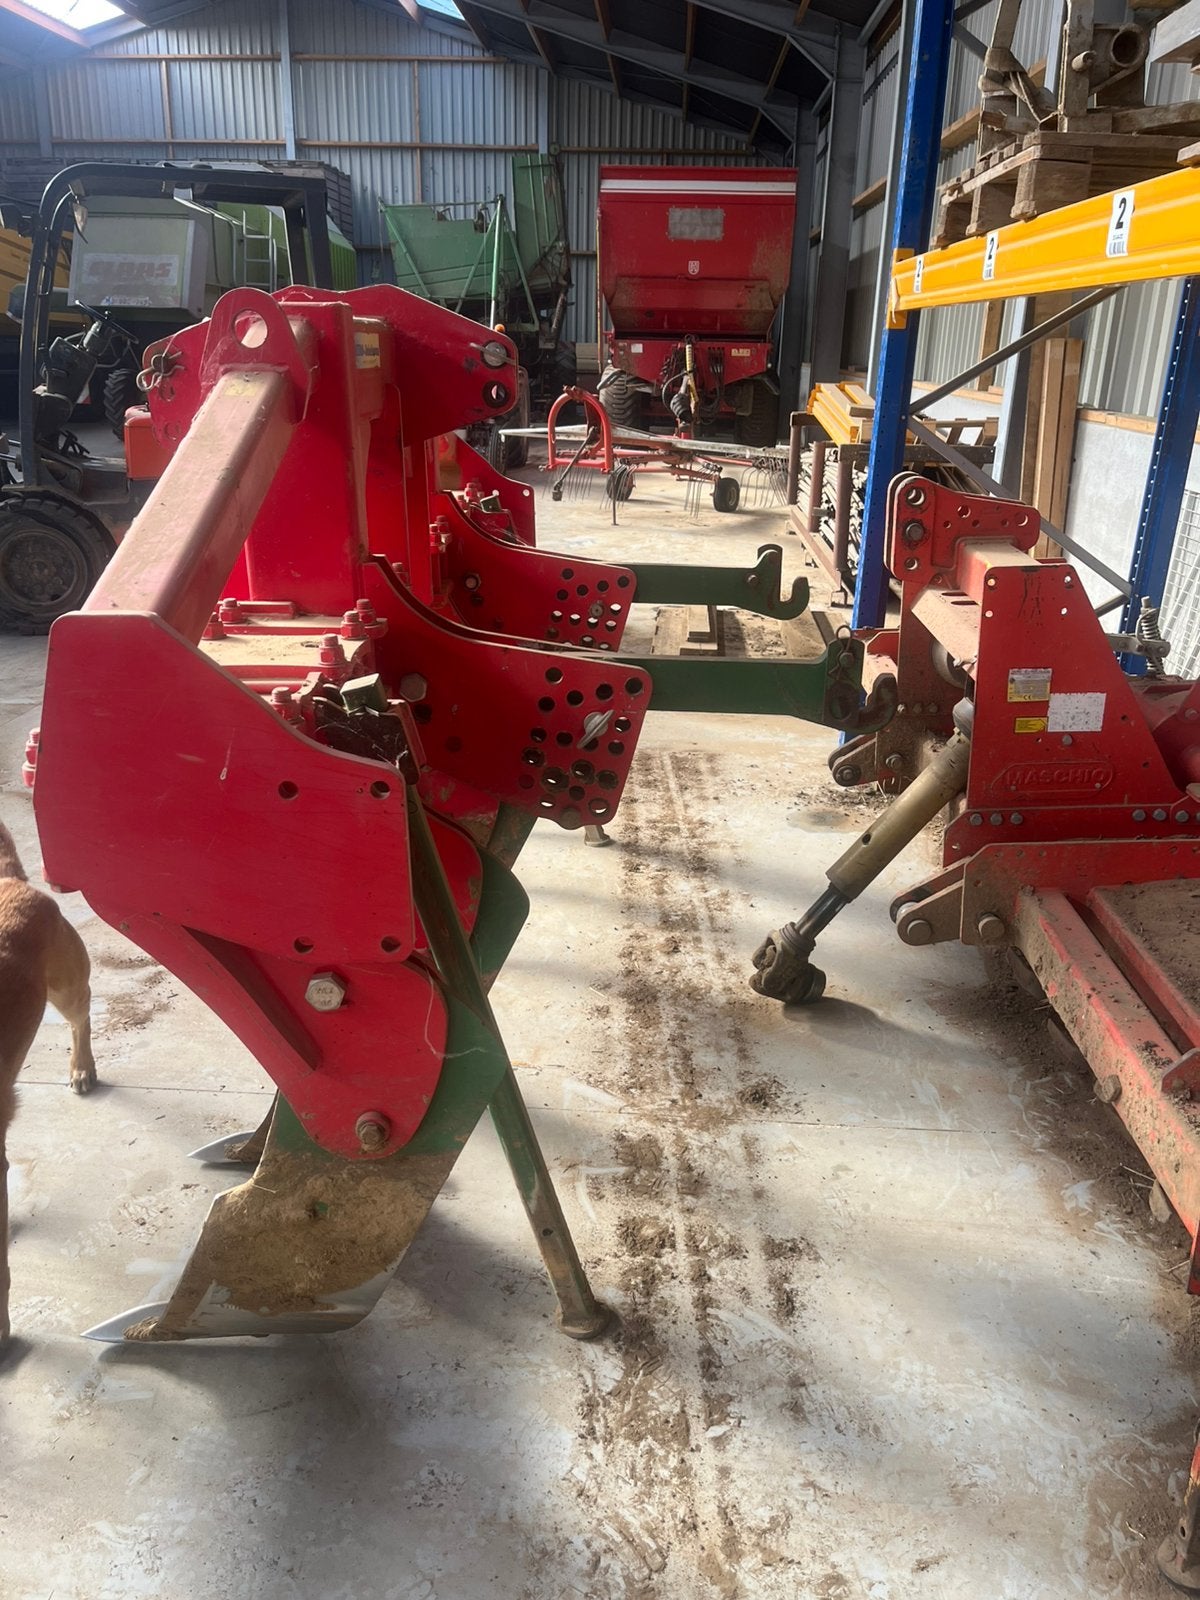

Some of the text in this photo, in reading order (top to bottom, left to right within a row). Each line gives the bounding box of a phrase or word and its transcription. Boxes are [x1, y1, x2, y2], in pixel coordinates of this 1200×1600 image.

[1115, 197, 1127, 230] 2
[988, 237, 995, 260] 2
[1008, 768, 1103, 785] MASCHIO
